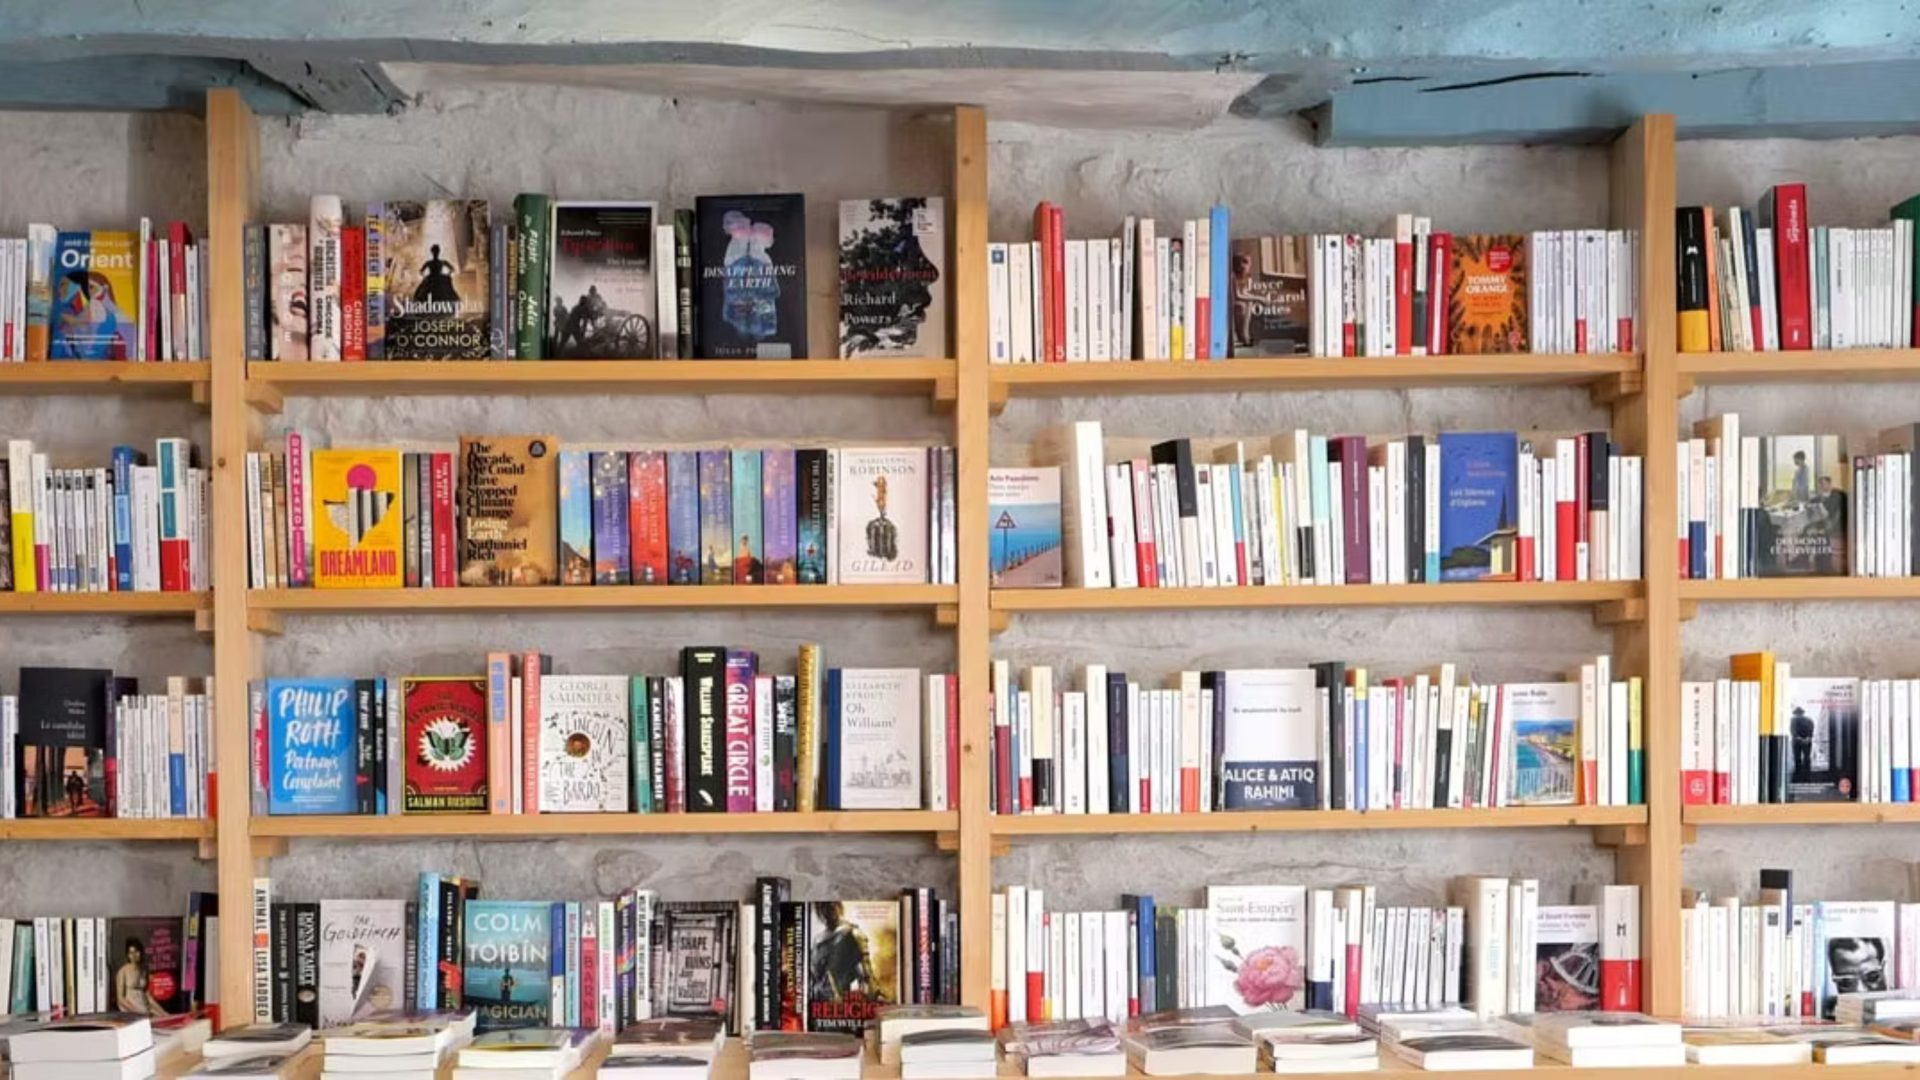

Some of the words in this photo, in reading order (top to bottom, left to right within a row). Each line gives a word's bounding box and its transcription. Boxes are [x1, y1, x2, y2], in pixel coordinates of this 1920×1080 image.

[61, 249, 134, 269] Orient
[703, 265, 797, 278] DISAPPEARING
[727, 278, 772, 289] EARTH
[1246, 277, 1284, 293] Joyce
[1467, 275, 1507, 285] TOMMY
[1465, 284, 1508, 294] ORANGE
[843, 291, 896, 305] Richard
[389, 293, 485, 318] Shadowplay
[1251, 302, 1291, 316] Oates
[344, 305, 352, 346] OBIOMA
[353, 300, 363, 350] CHIGOZIE
[844, 312, 892, 325] Powers
[412, 320, 465, 333] JOSEPH
[397, 334, 482, 347] O'CONNOR
[468, 442, 490, 454] The
[467, 453, 512, 465] Decade
[467, 463, 488, 475] We
[488, 463, 525, 475] Could
[849, 465, 916, 475] ROBINSON
[290, 437, 302, 524] DREAMLAND
[467, 475, 498, 486] Have
[466, 485, 518, 498] Stopped
[466, 496, 514, 508] Climate
[466, 507, 513, 519] Change
[466, 517, 508, 530] Losing
[467, 529, 502, 540] Earth
[466, 539, 527, 550] Nathaniel
[467, 550, 496, 561] Rich
[319, 550, 398, 576] DREAMLAND
[851, 559, 914, 573] GILEAD
[559, 681, 609, 691] GEORGE
[549, 692, 621, 703] SAUNDERS
[699, 676, 714, 715] WILLIAM
[279, 688, 347, 718] PHILIP
[727, 682, 749, 734] GREAT
[846, 703, 865, 713] Oh
[776, 702, 787, 733] SMITH
[847, 716, 897, 729] William!
[286, 720, 341, 748] ROTH
[653, 751, 664, 800] SHAMSIE
[727, 740, 749, 797] CIRCLE
[1223, 768, 1265, 782] ALICE
[1268, 768, 1279, 781] &
[1280, 767, 1314, 784] ATIQ
[282, 772, 342, 792] Complaint
[563, 780, 601, 805] BARDO
[1244, 785, 1294, 799] RAHIMI
[408, 796, 445, 807] SALMAN
[447, 795, 485, 807] RUSHDIE
[255, 888, 267, 930] ANIMAL
[1216, 901, 1297, 916] Saint-Exupéry
[473, 913, 542, 932] COLM
[304, 912, 315, 951] DONNA
[322, 922, 401, 944] GOLDFINCH
[786, 927, 794, 945] TIM
[680, 936, 707, 950] SHAPE
[466, 938, 547, 963] TÓIBÍN
[256, 951, 267, 973] LISA
[304, 952, 315, 986] TARTT
[685, 955, 711, 970] RUINS
[786, 946, 795, 993] WILLOCKS
[257, 976, 269, 1017] TADDEO
[810, 1000, 877, 1018] RELIGIO
[816, 1019, 836, 1028] TIM
